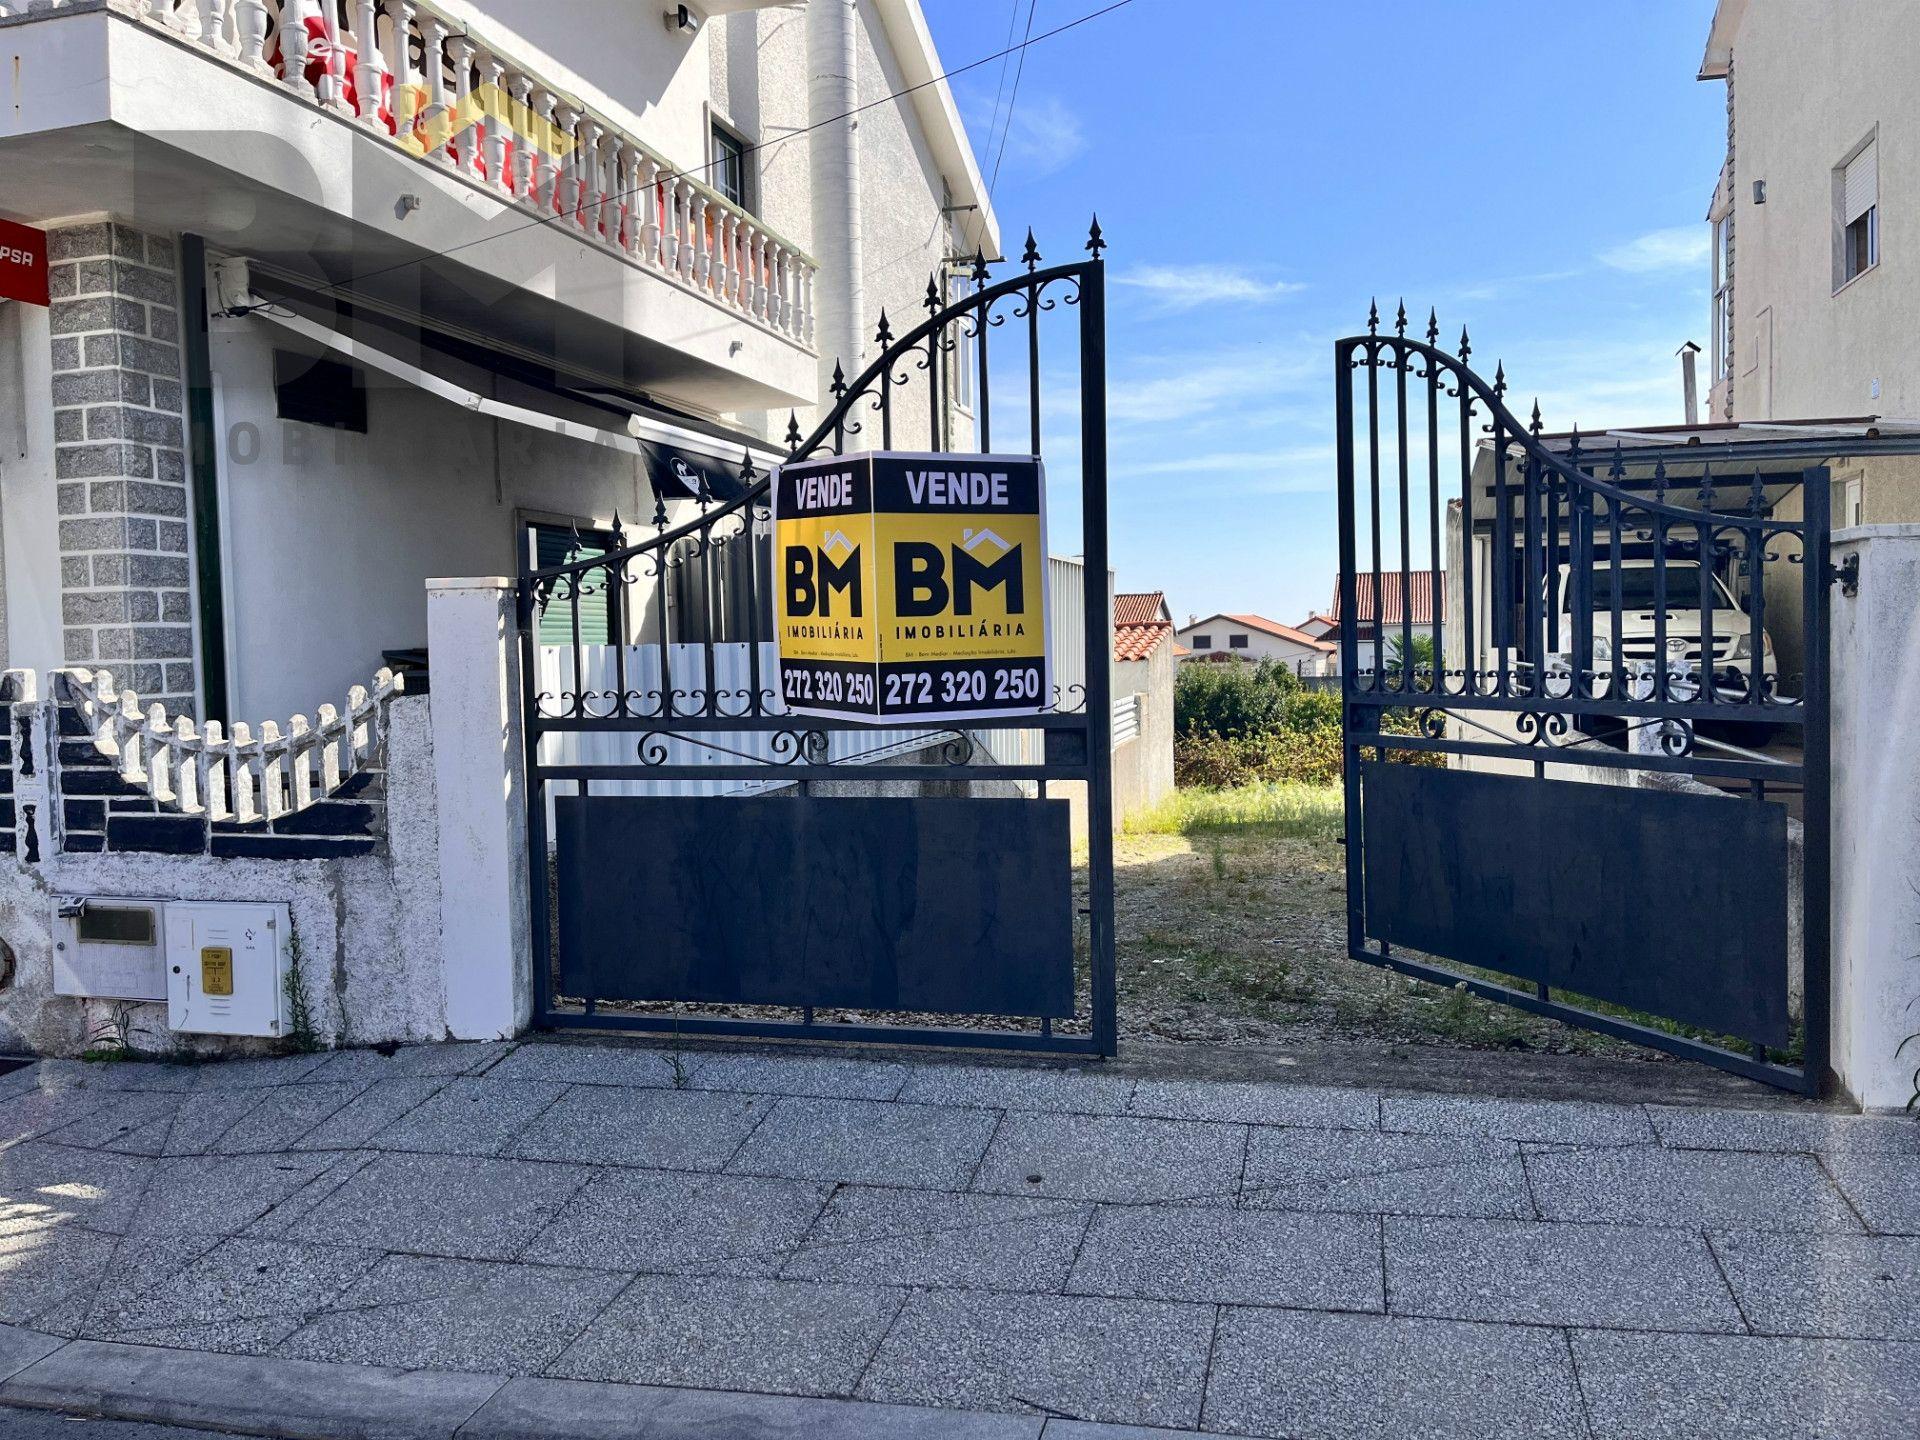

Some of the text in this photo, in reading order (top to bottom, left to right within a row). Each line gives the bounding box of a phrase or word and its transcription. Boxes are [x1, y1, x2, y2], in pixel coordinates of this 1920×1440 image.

[796, 472, 853, 510] VENDE
[905, 471, 1009, 505] VENDE
[786, 543, 862, 617] BM
[894, 542, 1025, 617] BM
[787, 621, 864, 640] IMOBILIÁRIA
[896, 619, 1025, 640] IMOBILIÁRIA
[784, 669, 873, 705] 272 320 250
[886, 668, 1039, 705] 272 320 250
